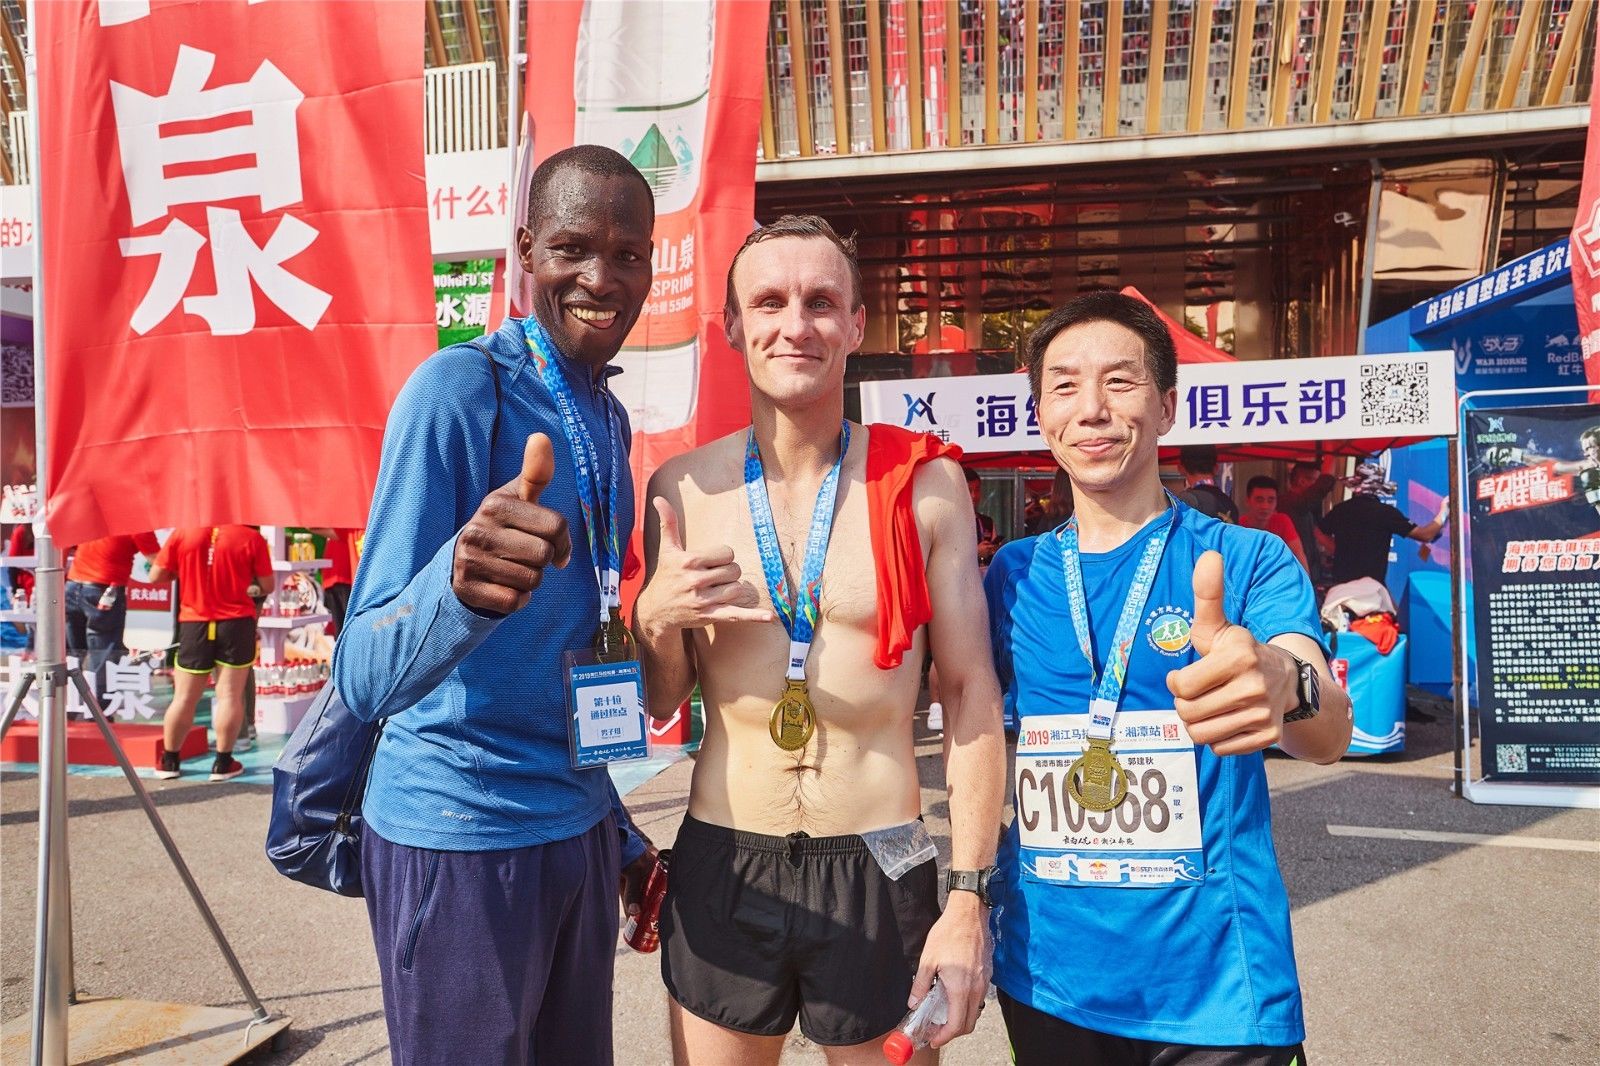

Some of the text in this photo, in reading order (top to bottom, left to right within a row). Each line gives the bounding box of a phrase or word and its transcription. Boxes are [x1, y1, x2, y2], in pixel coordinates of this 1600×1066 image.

[98, 0, 333, 336] 泉
[651, 233, 694, 277] 山泉
[1186, 378, 1348, 431] 俱乐部
[590, 707, 628, 720] 通过终点
[593, 694, 622, 707] 第十位
[1026, 729, 1049, 746] 2019
